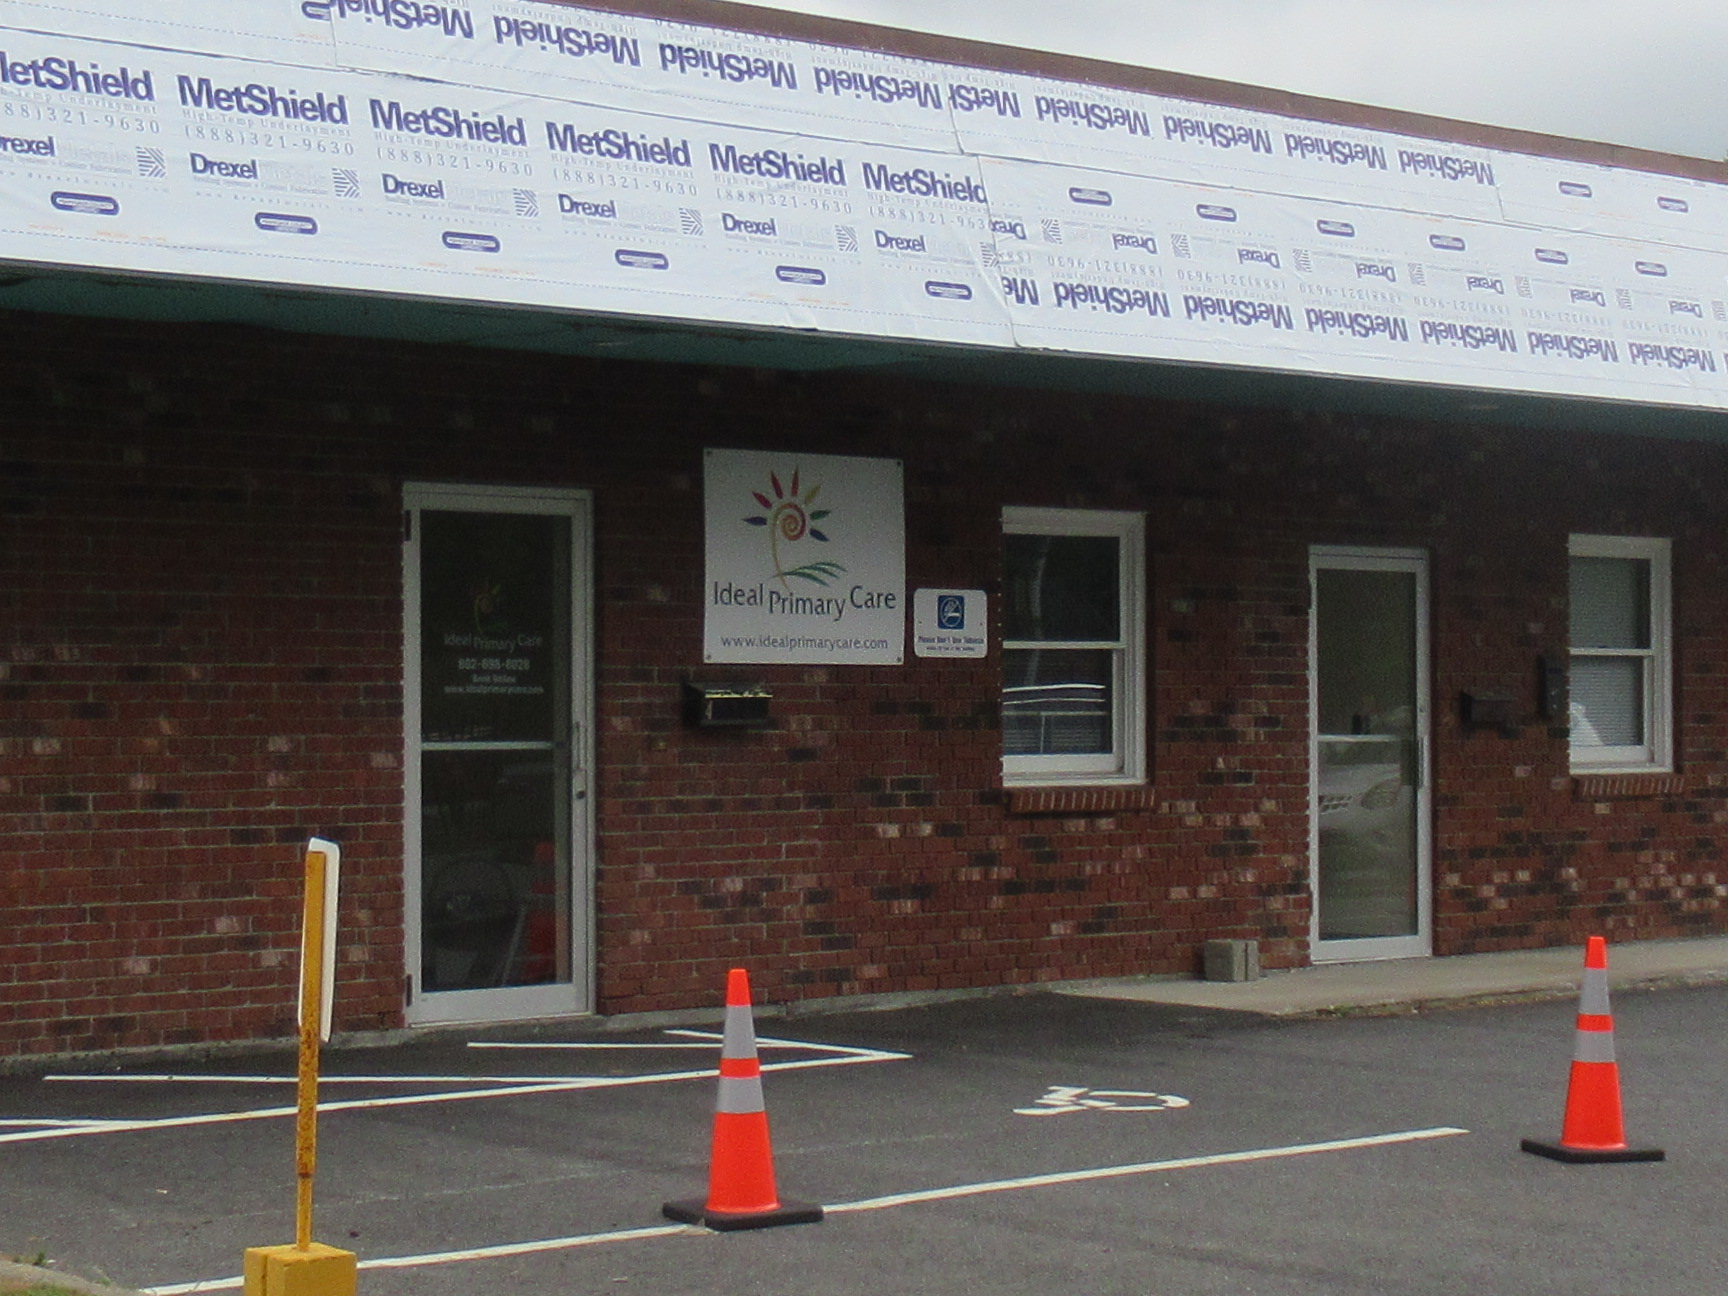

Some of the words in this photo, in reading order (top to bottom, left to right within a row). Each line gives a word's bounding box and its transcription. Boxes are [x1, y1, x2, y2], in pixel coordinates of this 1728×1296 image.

[492, 15, 642, 67] MetShield
[658, 41, 798, 90] MetShield
[176, 74, 349, 125] MetShield
[812, 62, 943, 111] MetShield
[368, 98, 527, 147] MetShield
[1033, 95, 1151, 137] MetShield
[184, 121, 356, 158] (888)321-9630
[545, 121, 692, 167] MetShield
[1162, 115, 1273, 155] MetShield
[1283, 132, 1388, 171] MetShield
[189, 152, 258, 180] Drexel
[376, 144, 534, 179] (888)321-9630
[708, 143, 847, 186] MetShield
[1397, 149, 1495, 187] MetShield
[381, 173, 445, 200] Drexel
[553, 165, 699, 198] (888)321-9630
[557, 193, 617, 219] Drexel
[716, 185, 854, 216] (888)321-9630
[721, 212, 777, 236] Drexel
[874, 229, 926, 252] Drexel
[1111, 233, 1158, 255] Drexel
[1237, 248, 1281, 269] Drexel
[1054, 278, 1171, 318] MetShield
[1184, 294, 1295, 330] MetShield
[1304, 306, 1409, 342] MetShield
[1419, 319, 1518, 352] MetShield
[1526, 331, 1620, 363] MetShield
[1627, 342, 1717, 373] MetShield
[713, 581, 764, 606] Ideal
[769, 590, 847, 621] Primary
[850, 585, 896, 610] Care
[720, 634, 889, 651] www.idealprimarycare.com
